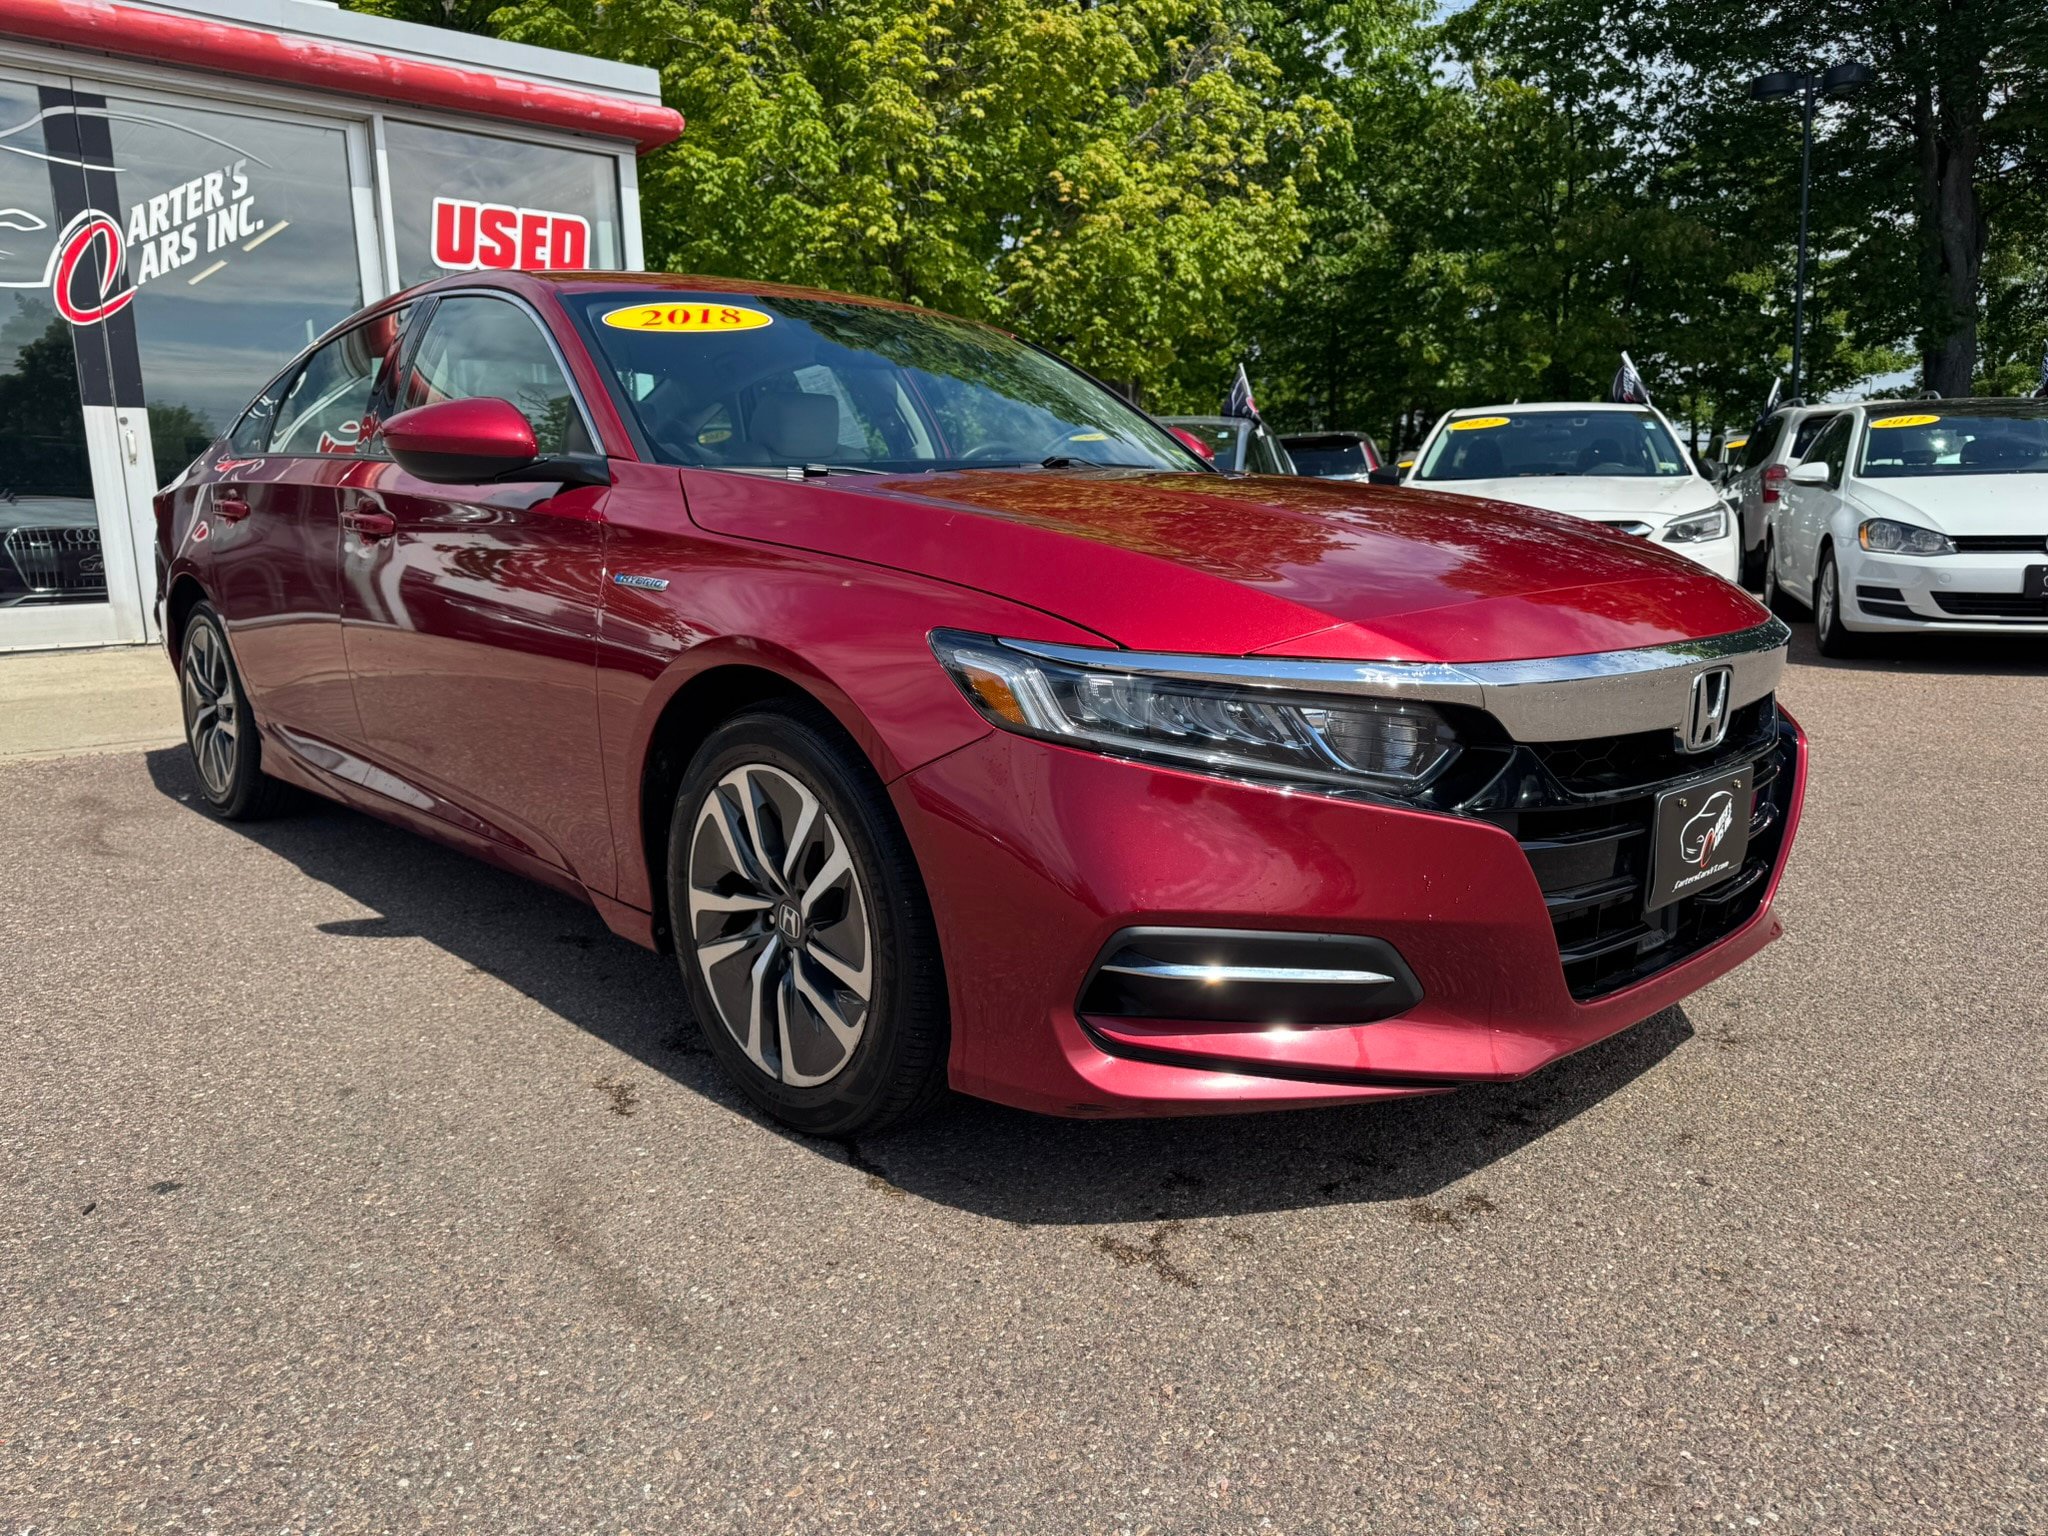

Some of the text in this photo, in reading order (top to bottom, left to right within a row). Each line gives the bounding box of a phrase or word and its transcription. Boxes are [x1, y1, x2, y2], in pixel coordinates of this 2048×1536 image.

[207, 196, 264, 253] INC.
[434, 200, 588, 270] USED
[640, 307, 742, 327] 2018
